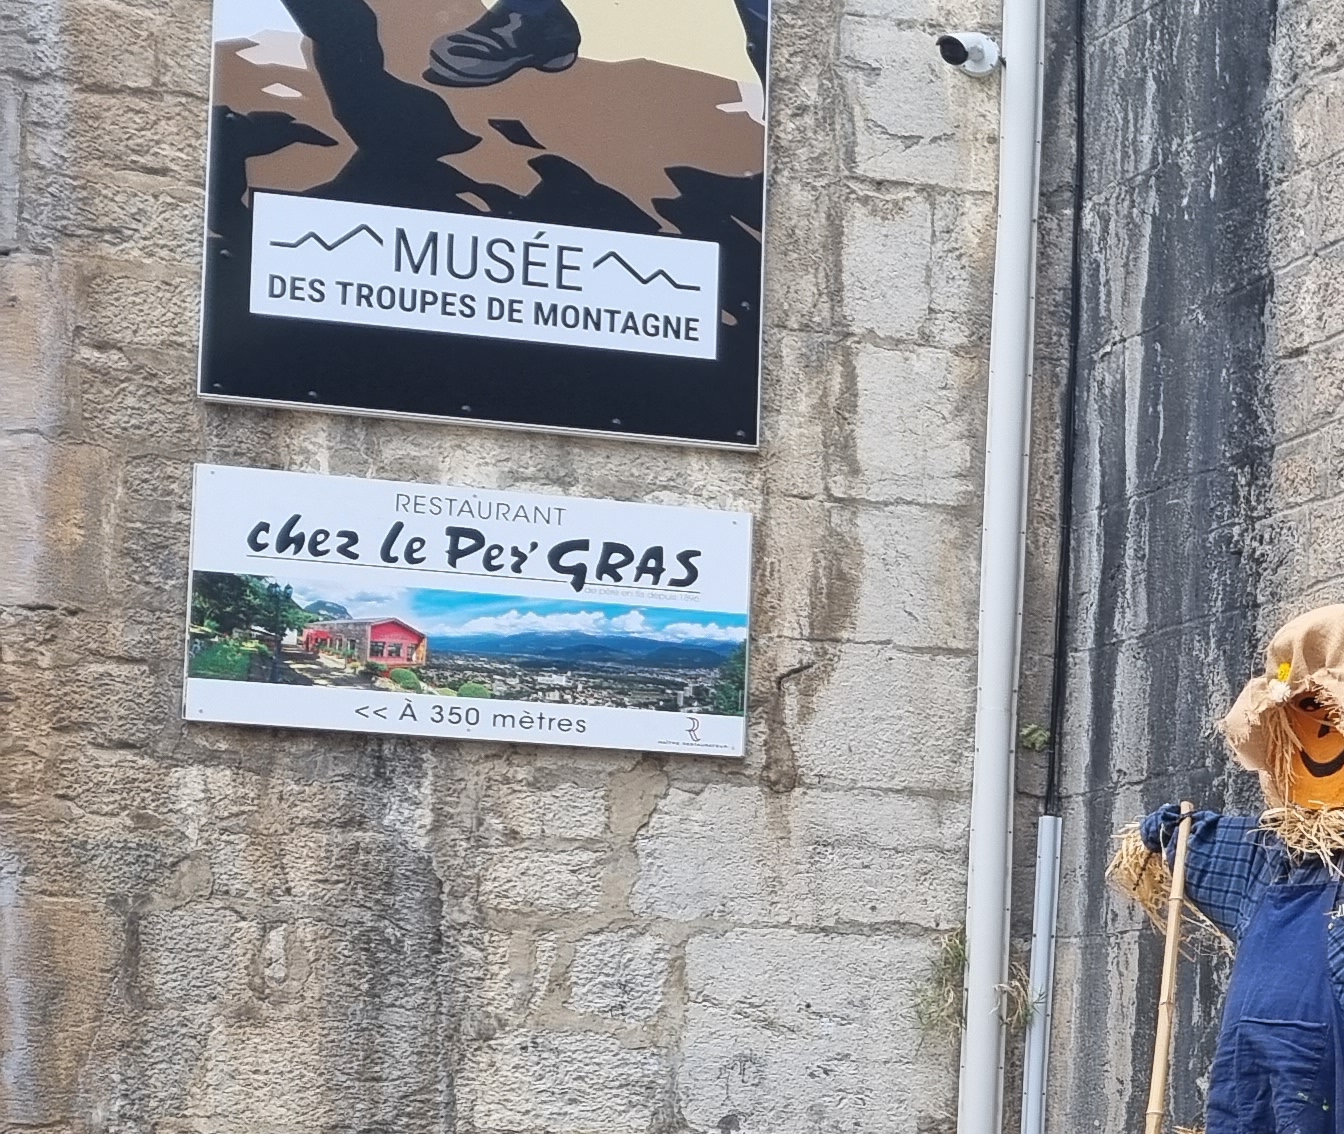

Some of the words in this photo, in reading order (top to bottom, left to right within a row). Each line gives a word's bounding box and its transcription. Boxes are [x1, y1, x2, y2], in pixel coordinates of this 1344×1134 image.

[393, 227, 584, 291] MUSÉE
[268, 274, 325, 303] DES
[335, 280, 476, 320] TROUPES
[487, 297, 523, 323] DE
[533, 302, 700, 342] MONTAGNE
[395, 493, 567, 526] RESTAURANT
[246, 514, 361, 562] chez
[380, 521, 426, 565] le
[399, 698, 418, 722] À
[430, 706, 480, 727] 350
[492, 709, 587, 734] mètres
